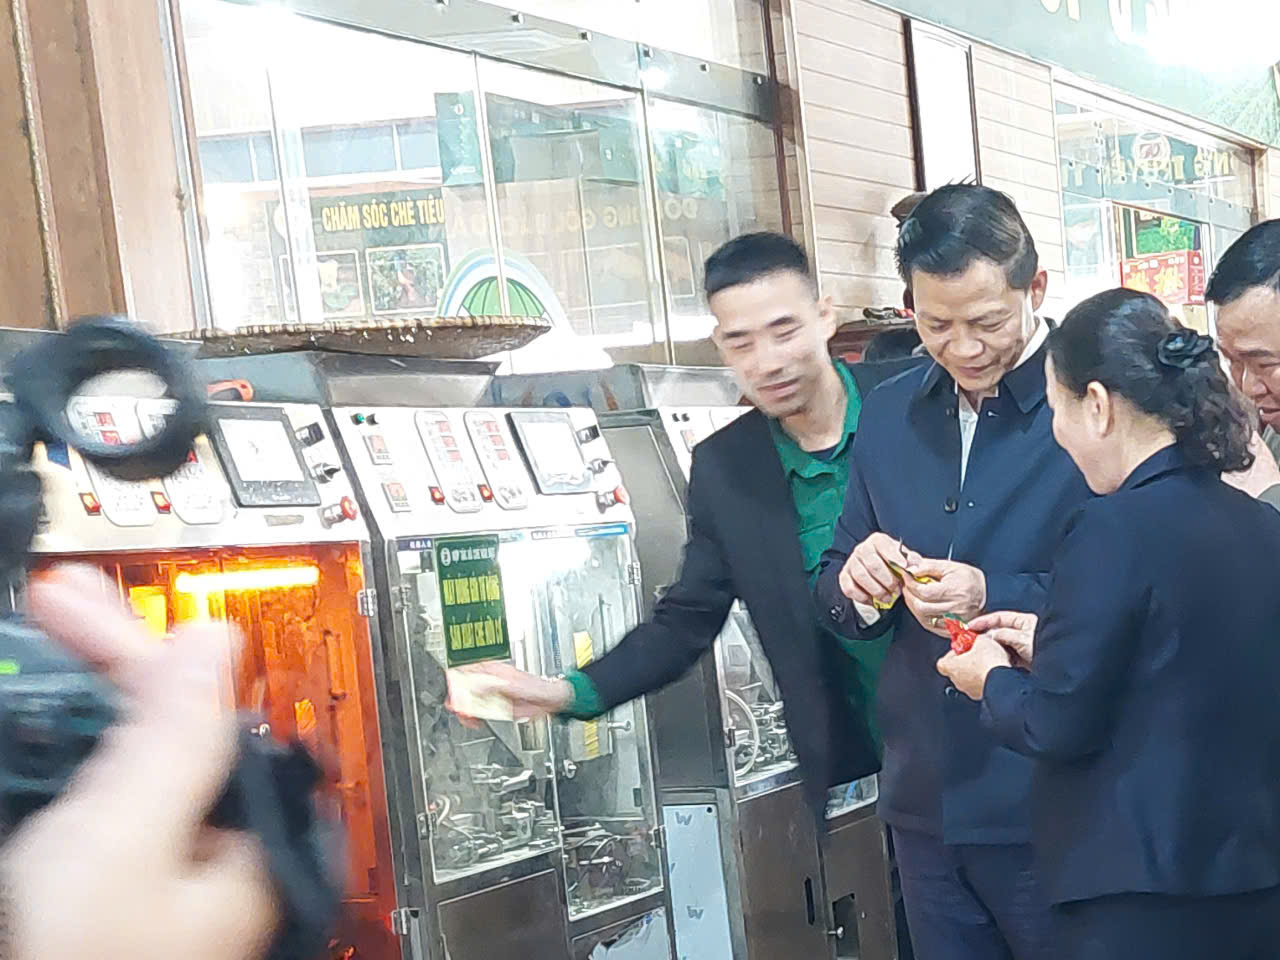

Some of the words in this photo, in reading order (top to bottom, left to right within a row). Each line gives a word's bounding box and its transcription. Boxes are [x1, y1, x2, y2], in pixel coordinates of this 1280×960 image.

[322, 201, 360, 232] CHĂM
[362, 198, 389, 229] SÓC
[390, 196, 416, 227] CHÈ
